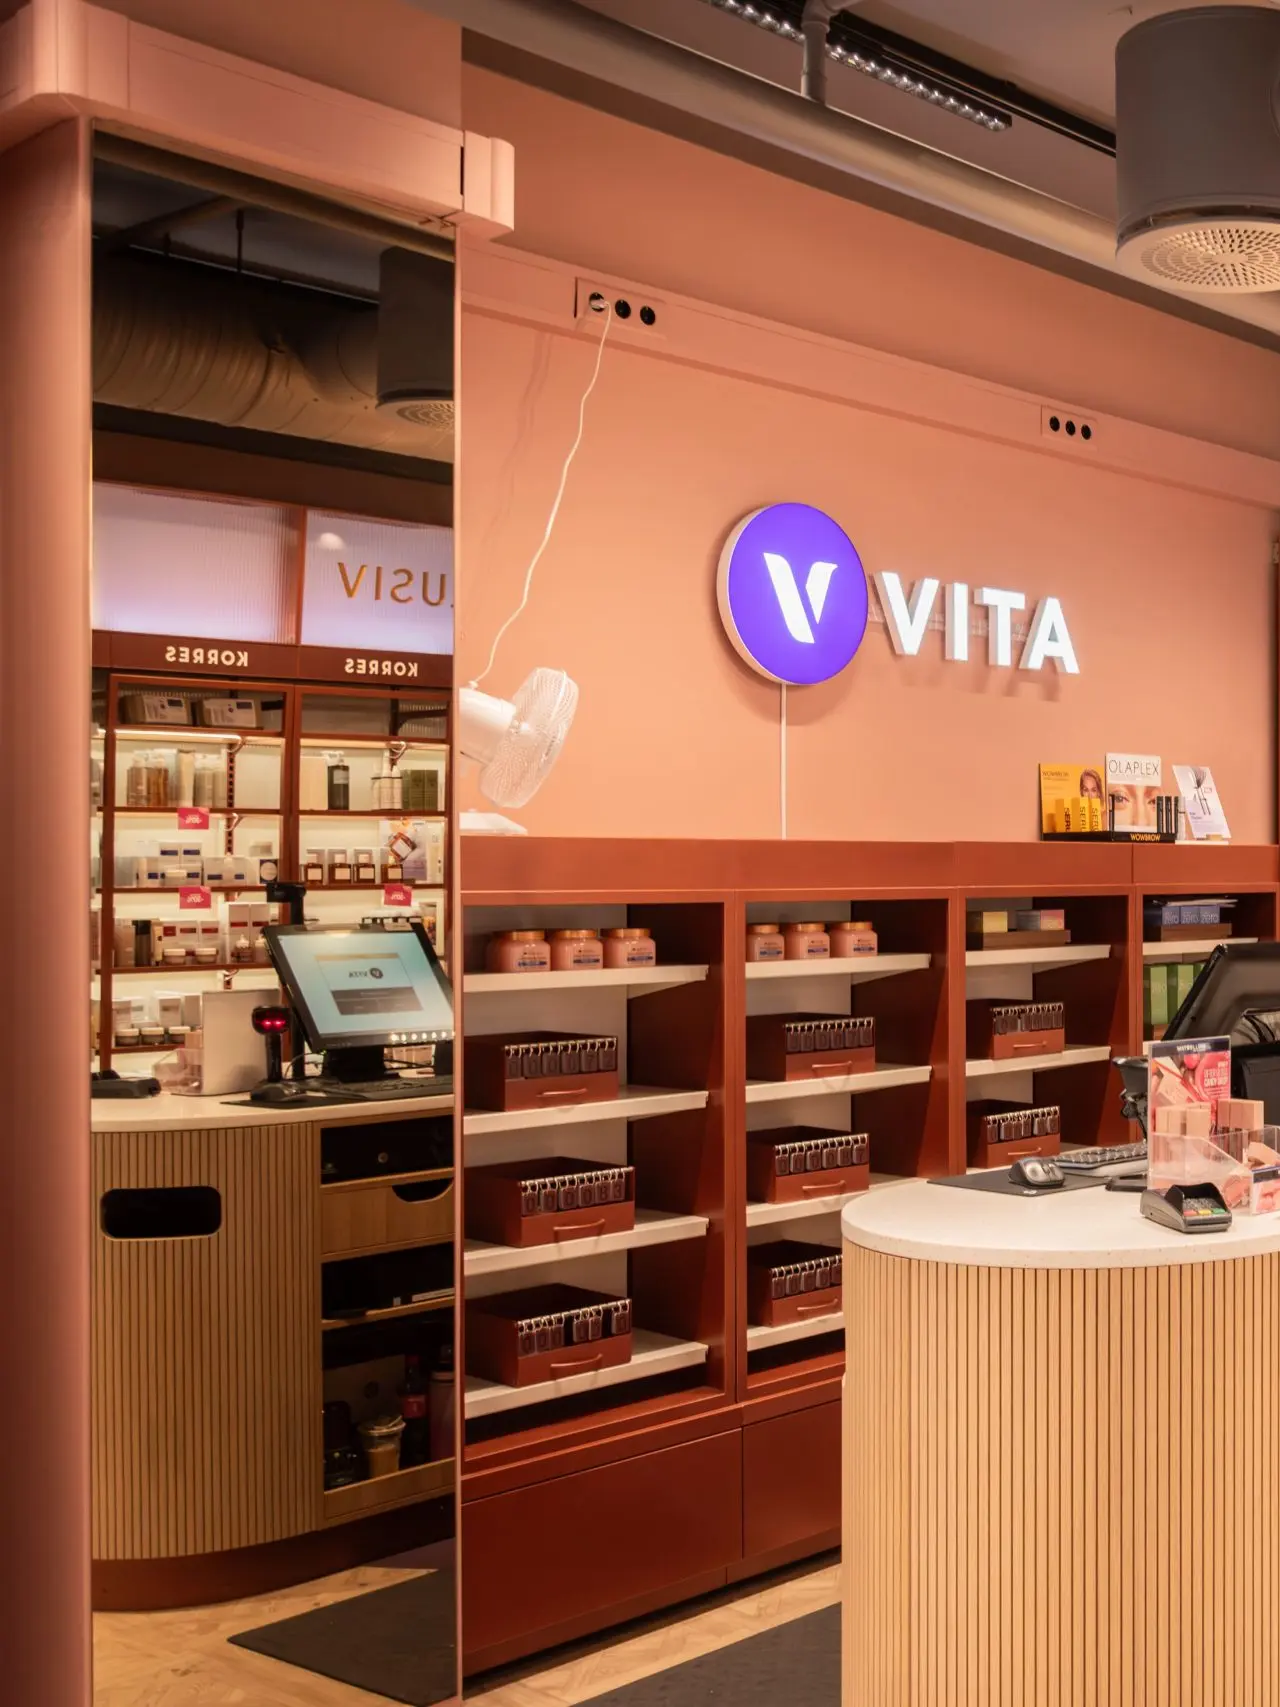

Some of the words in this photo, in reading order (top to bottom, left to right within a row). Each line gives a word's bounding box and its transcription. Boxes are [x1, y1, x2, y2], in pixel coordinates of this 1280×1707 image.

[870, 570, 1081, 675] VITA
[1108, 759, 1160, 776] OLAPLEX
[1130, 833, 1161, 842] WOWBROW
